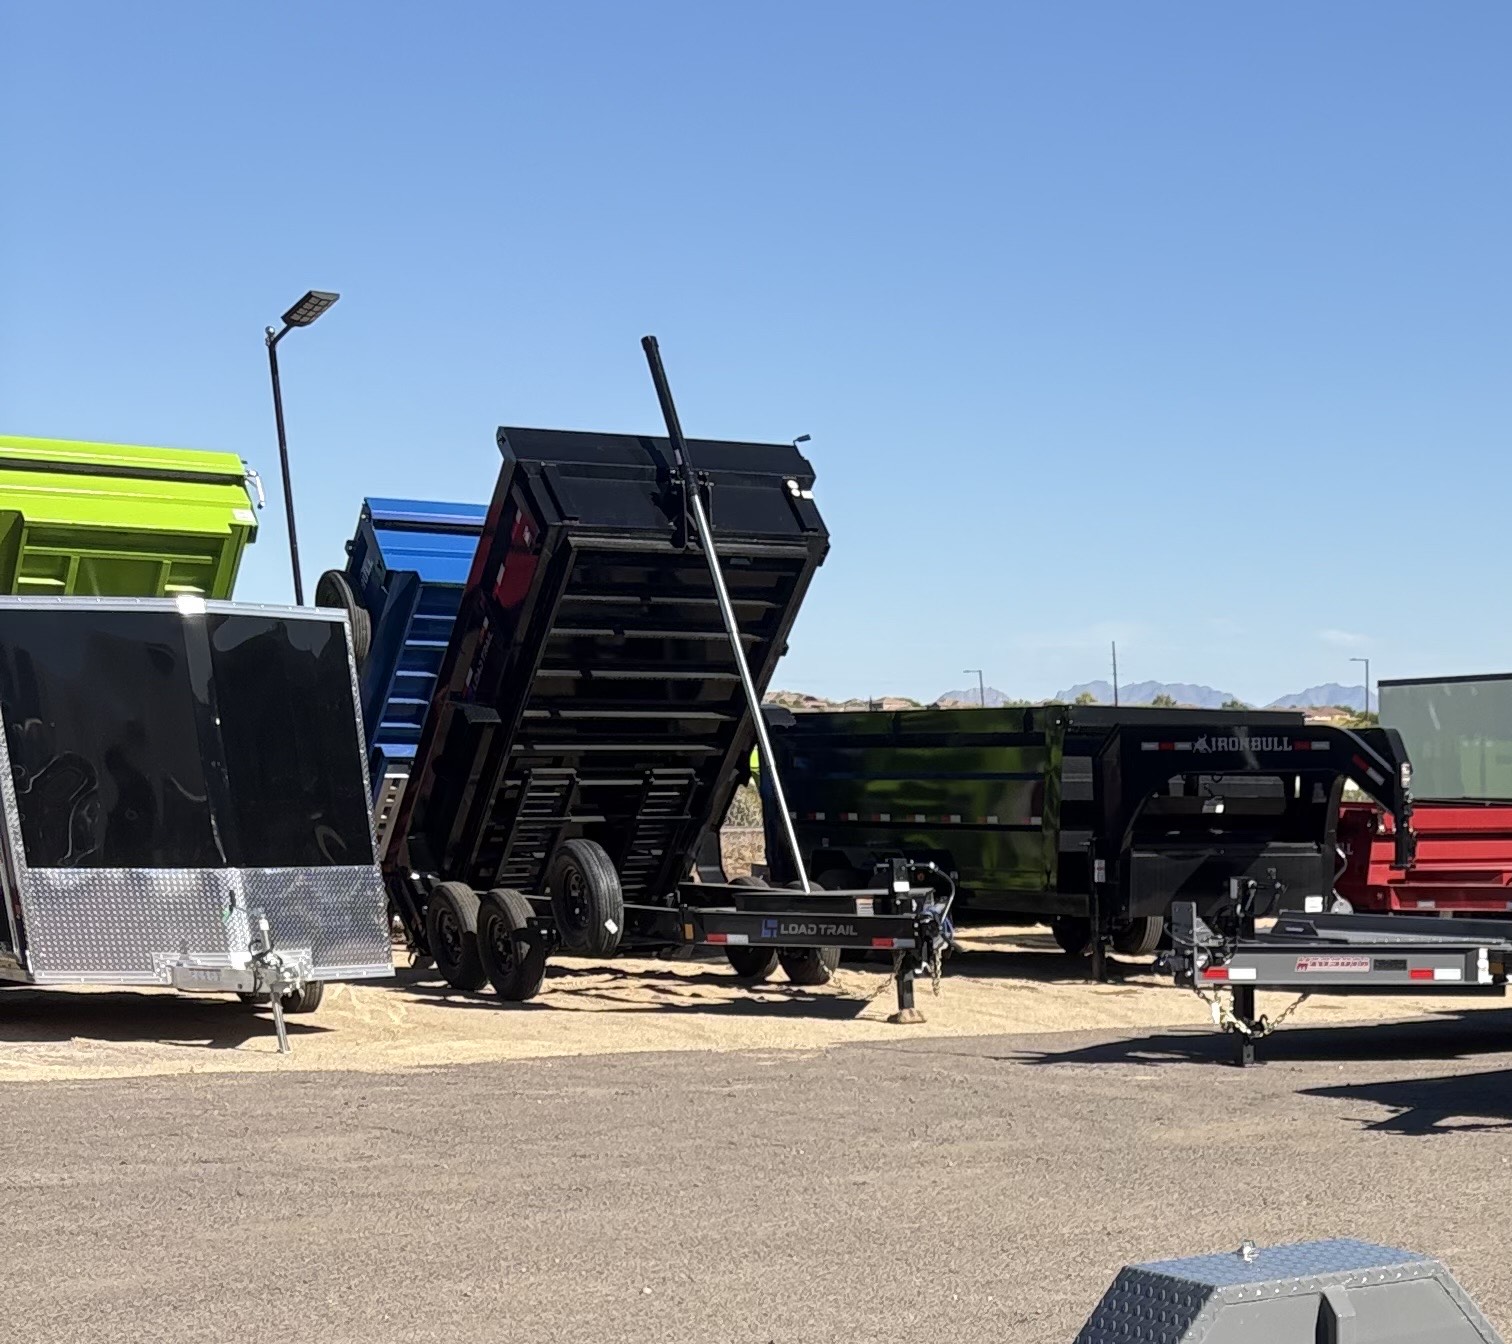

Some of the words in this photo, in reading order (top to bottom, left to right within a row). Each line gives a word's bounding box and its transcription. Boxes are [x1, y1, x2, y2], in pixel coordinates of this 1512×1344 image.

[1211, 736, 1293, 751] IRONBULL
[780, 923, 817, 935] LOAD
[818, 924, 858, 936] TRAIL
